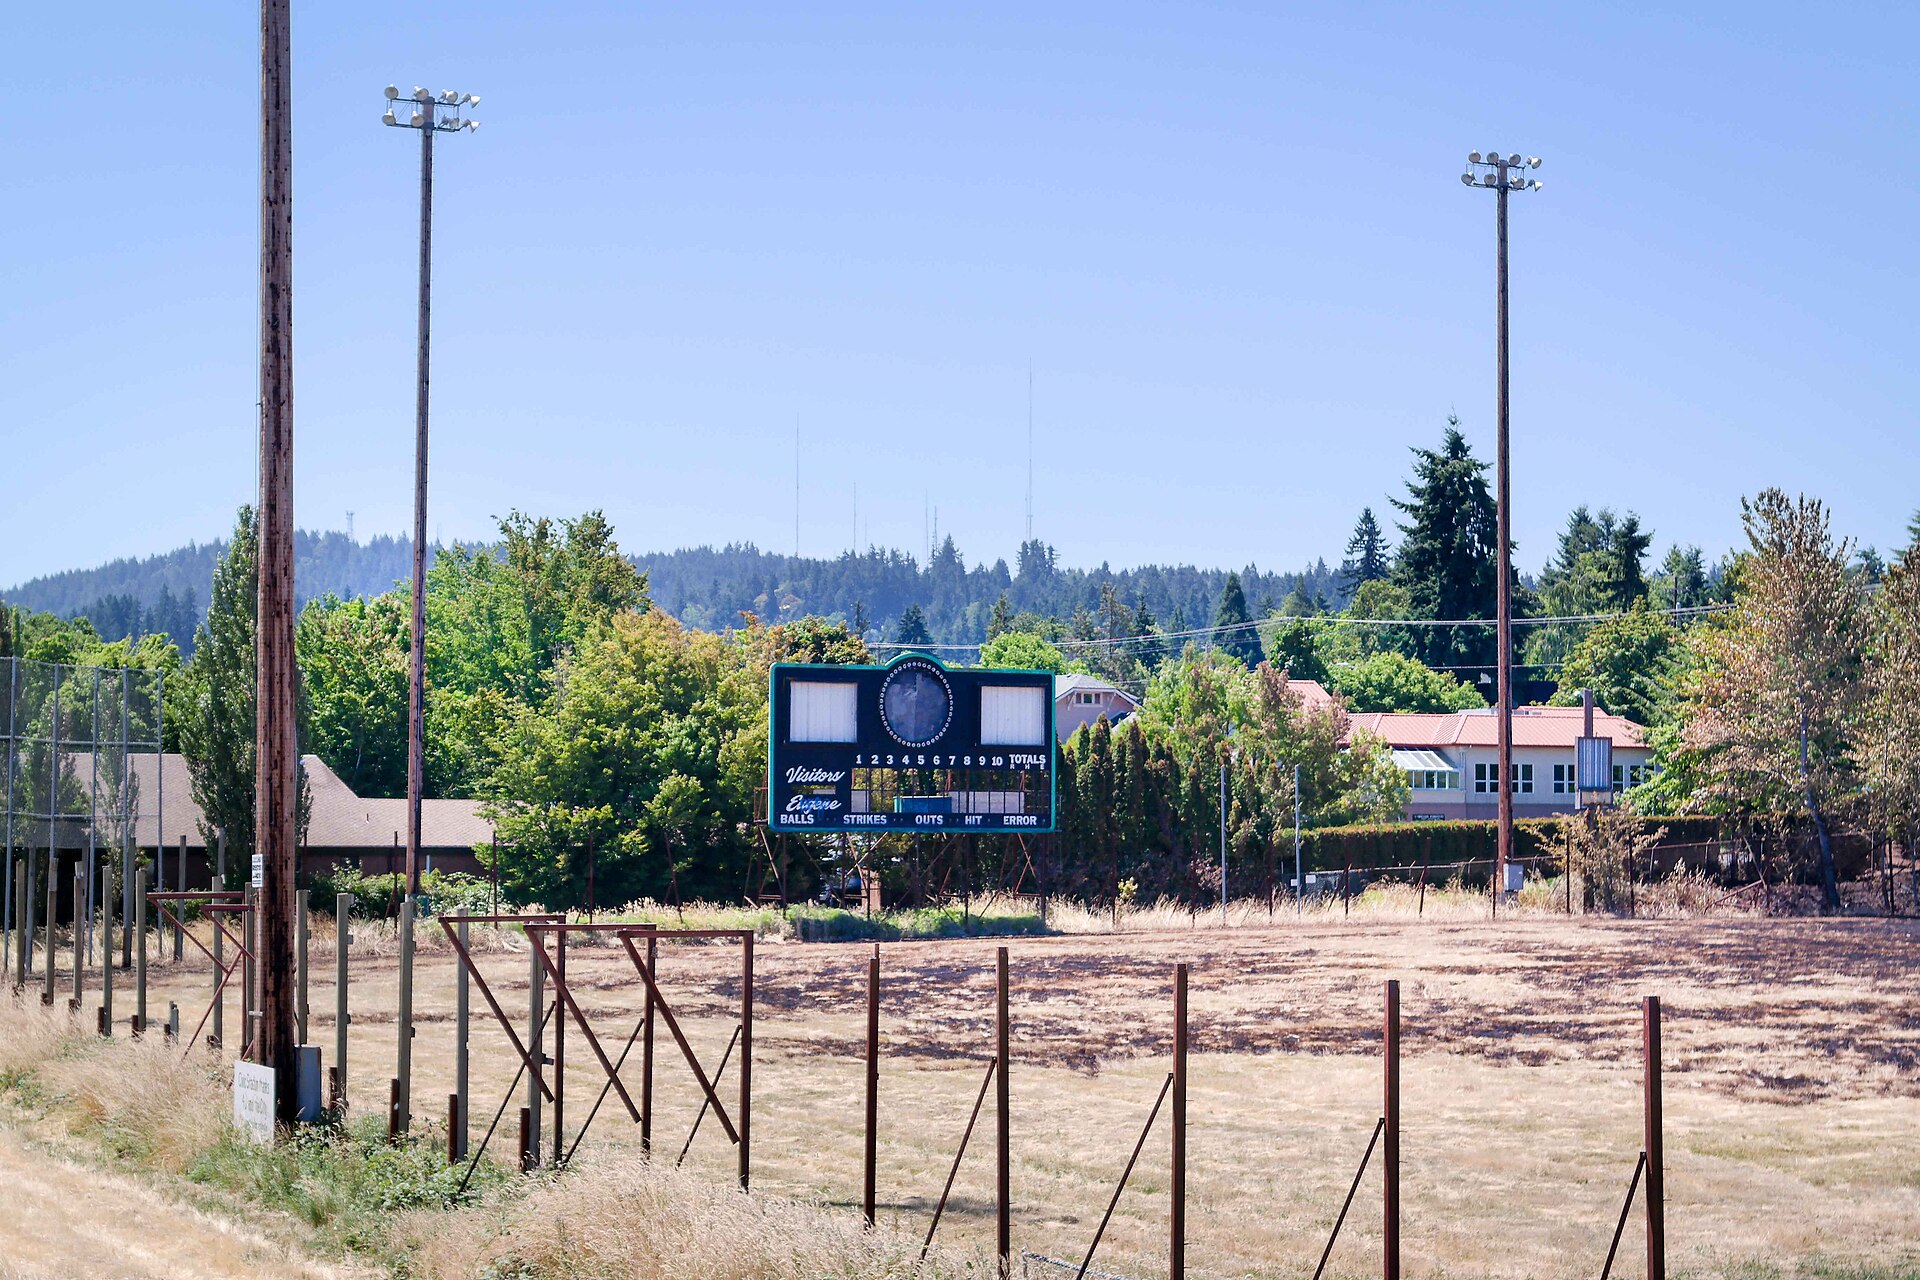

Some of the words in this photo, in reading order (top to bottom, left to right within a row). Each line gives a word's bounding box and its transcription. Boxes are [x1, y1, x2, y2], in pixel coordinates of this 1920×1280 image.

[856, 754, 861, 764] 1
[871, 754, 879, 765] 2
[886, 754, 894, 765] 3
[901, 754, 910, 765] 4
[917, 755, 925, 765] 5
[933, 755, 940, 766] 6
[949, 756, 956, 765] 7
[963, 755, 971, 766] 8
[978, 756, 986, 766] 9
[991, 756, 1003, 767] 10
[1009, 754, 1046, 764] TOTALS
[786, 765, 845, 784] Visitors
[780, 814, 815, 824] BALLS
[843, 815, 887, 824] STRIKES
[915, 814, 943, 825] OUTS
[965, 815, 982, 825] HIT
[1003, 815, 1037, 826] ERROR
